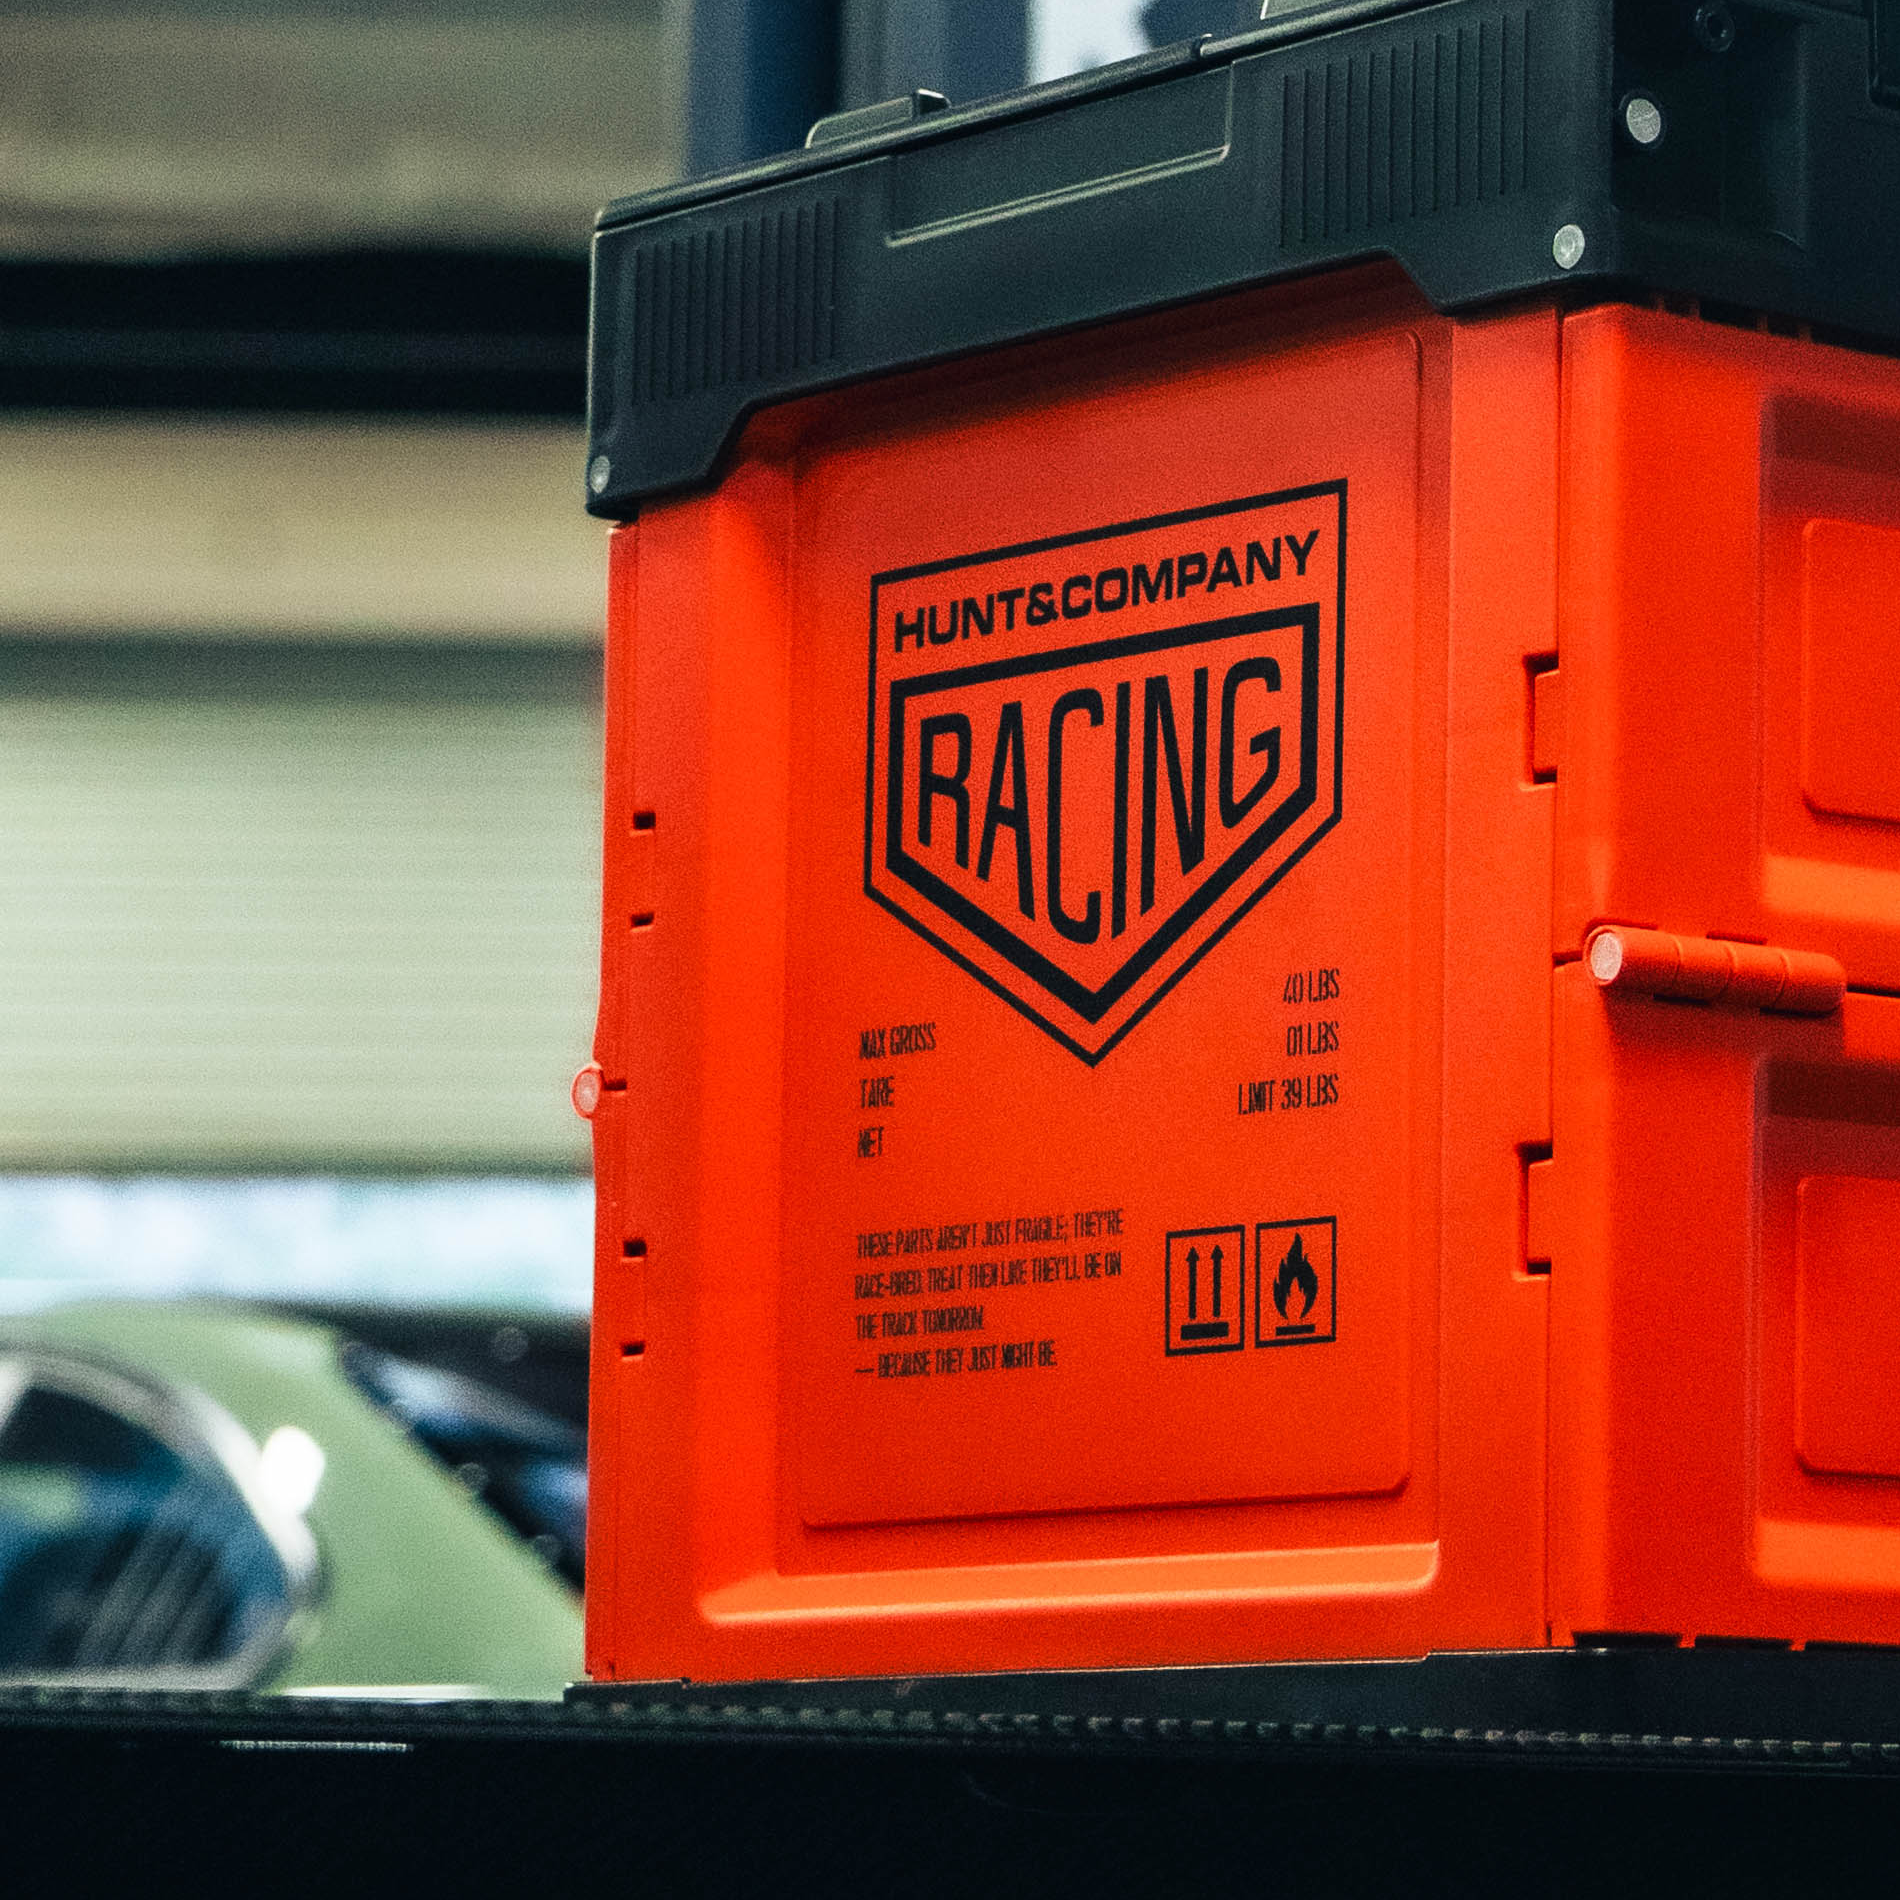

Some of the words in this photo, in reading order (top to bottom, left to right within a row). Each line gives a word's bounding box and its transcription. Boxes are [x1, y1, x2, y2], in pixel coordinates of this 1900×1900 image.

[894, 530, 1320, 653] HUNT&COMPANY
[917, 656, 1282, 945] RACING
[1283, 973, 1303, 1004] 40
[1309, 968, 1339, 1002] LBS
[859, 1029, 886, 1059] MAX
[890, 1022, 936, 1056] GROSS
[1287, 1025, 1303, 1056] 01
[1308, 1021, 1339, 1055] LBS
[860, 1076, 894, 1108] TARE
[1238, 1080, 1276, 1114] LIMIT
[1281, 1077, 1302, 1109] 39
[1307, 1074, 1339, 1107] LBS
[858, 1126, 884, 1157] NET
[857, 1231, 893, 1258] THESE
[896, 1228, 934, 1255] PARTS
[982, 1220, 1011, 1247] JUST
[928, 1265, 963, 1292] TREAT
[969, 1263, 998, 1289] THEM
[1001, 1259, 1027, 1285] LIKE
[1085, 1253, 1101, 1278] BE
[1105, 1251, 1121, 1277] ON
[856, 1313, 877, 1340] THE
[936, 1347, 964, 1374] THEY
[968, 1344, 997, 1372] JUST
